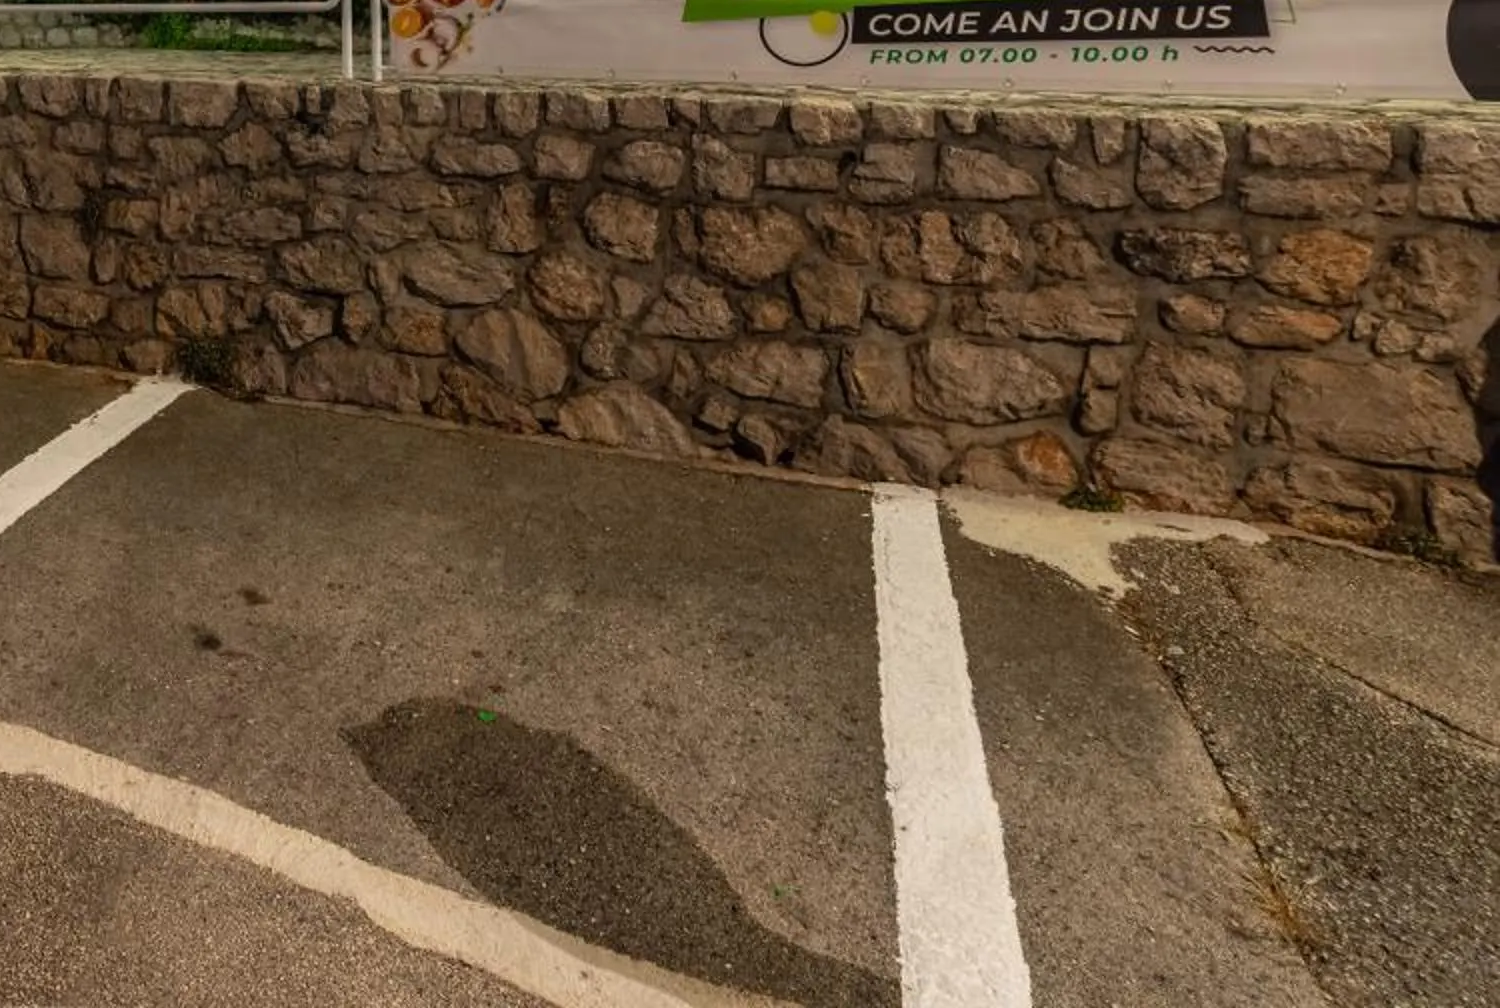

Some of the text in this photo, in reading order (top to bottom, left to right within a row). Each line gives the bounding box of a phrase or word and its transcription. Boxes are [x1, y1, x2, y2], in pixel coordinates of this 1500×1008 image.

[869, 5, 1233, 37] COME AN JOIN US
[869, 49, 948, 65] FROM
[959, 47, 1038, 64] 07.00
[1071, 45, 1149, 63] 10.00
[1161, 45, 1179, 62] h
